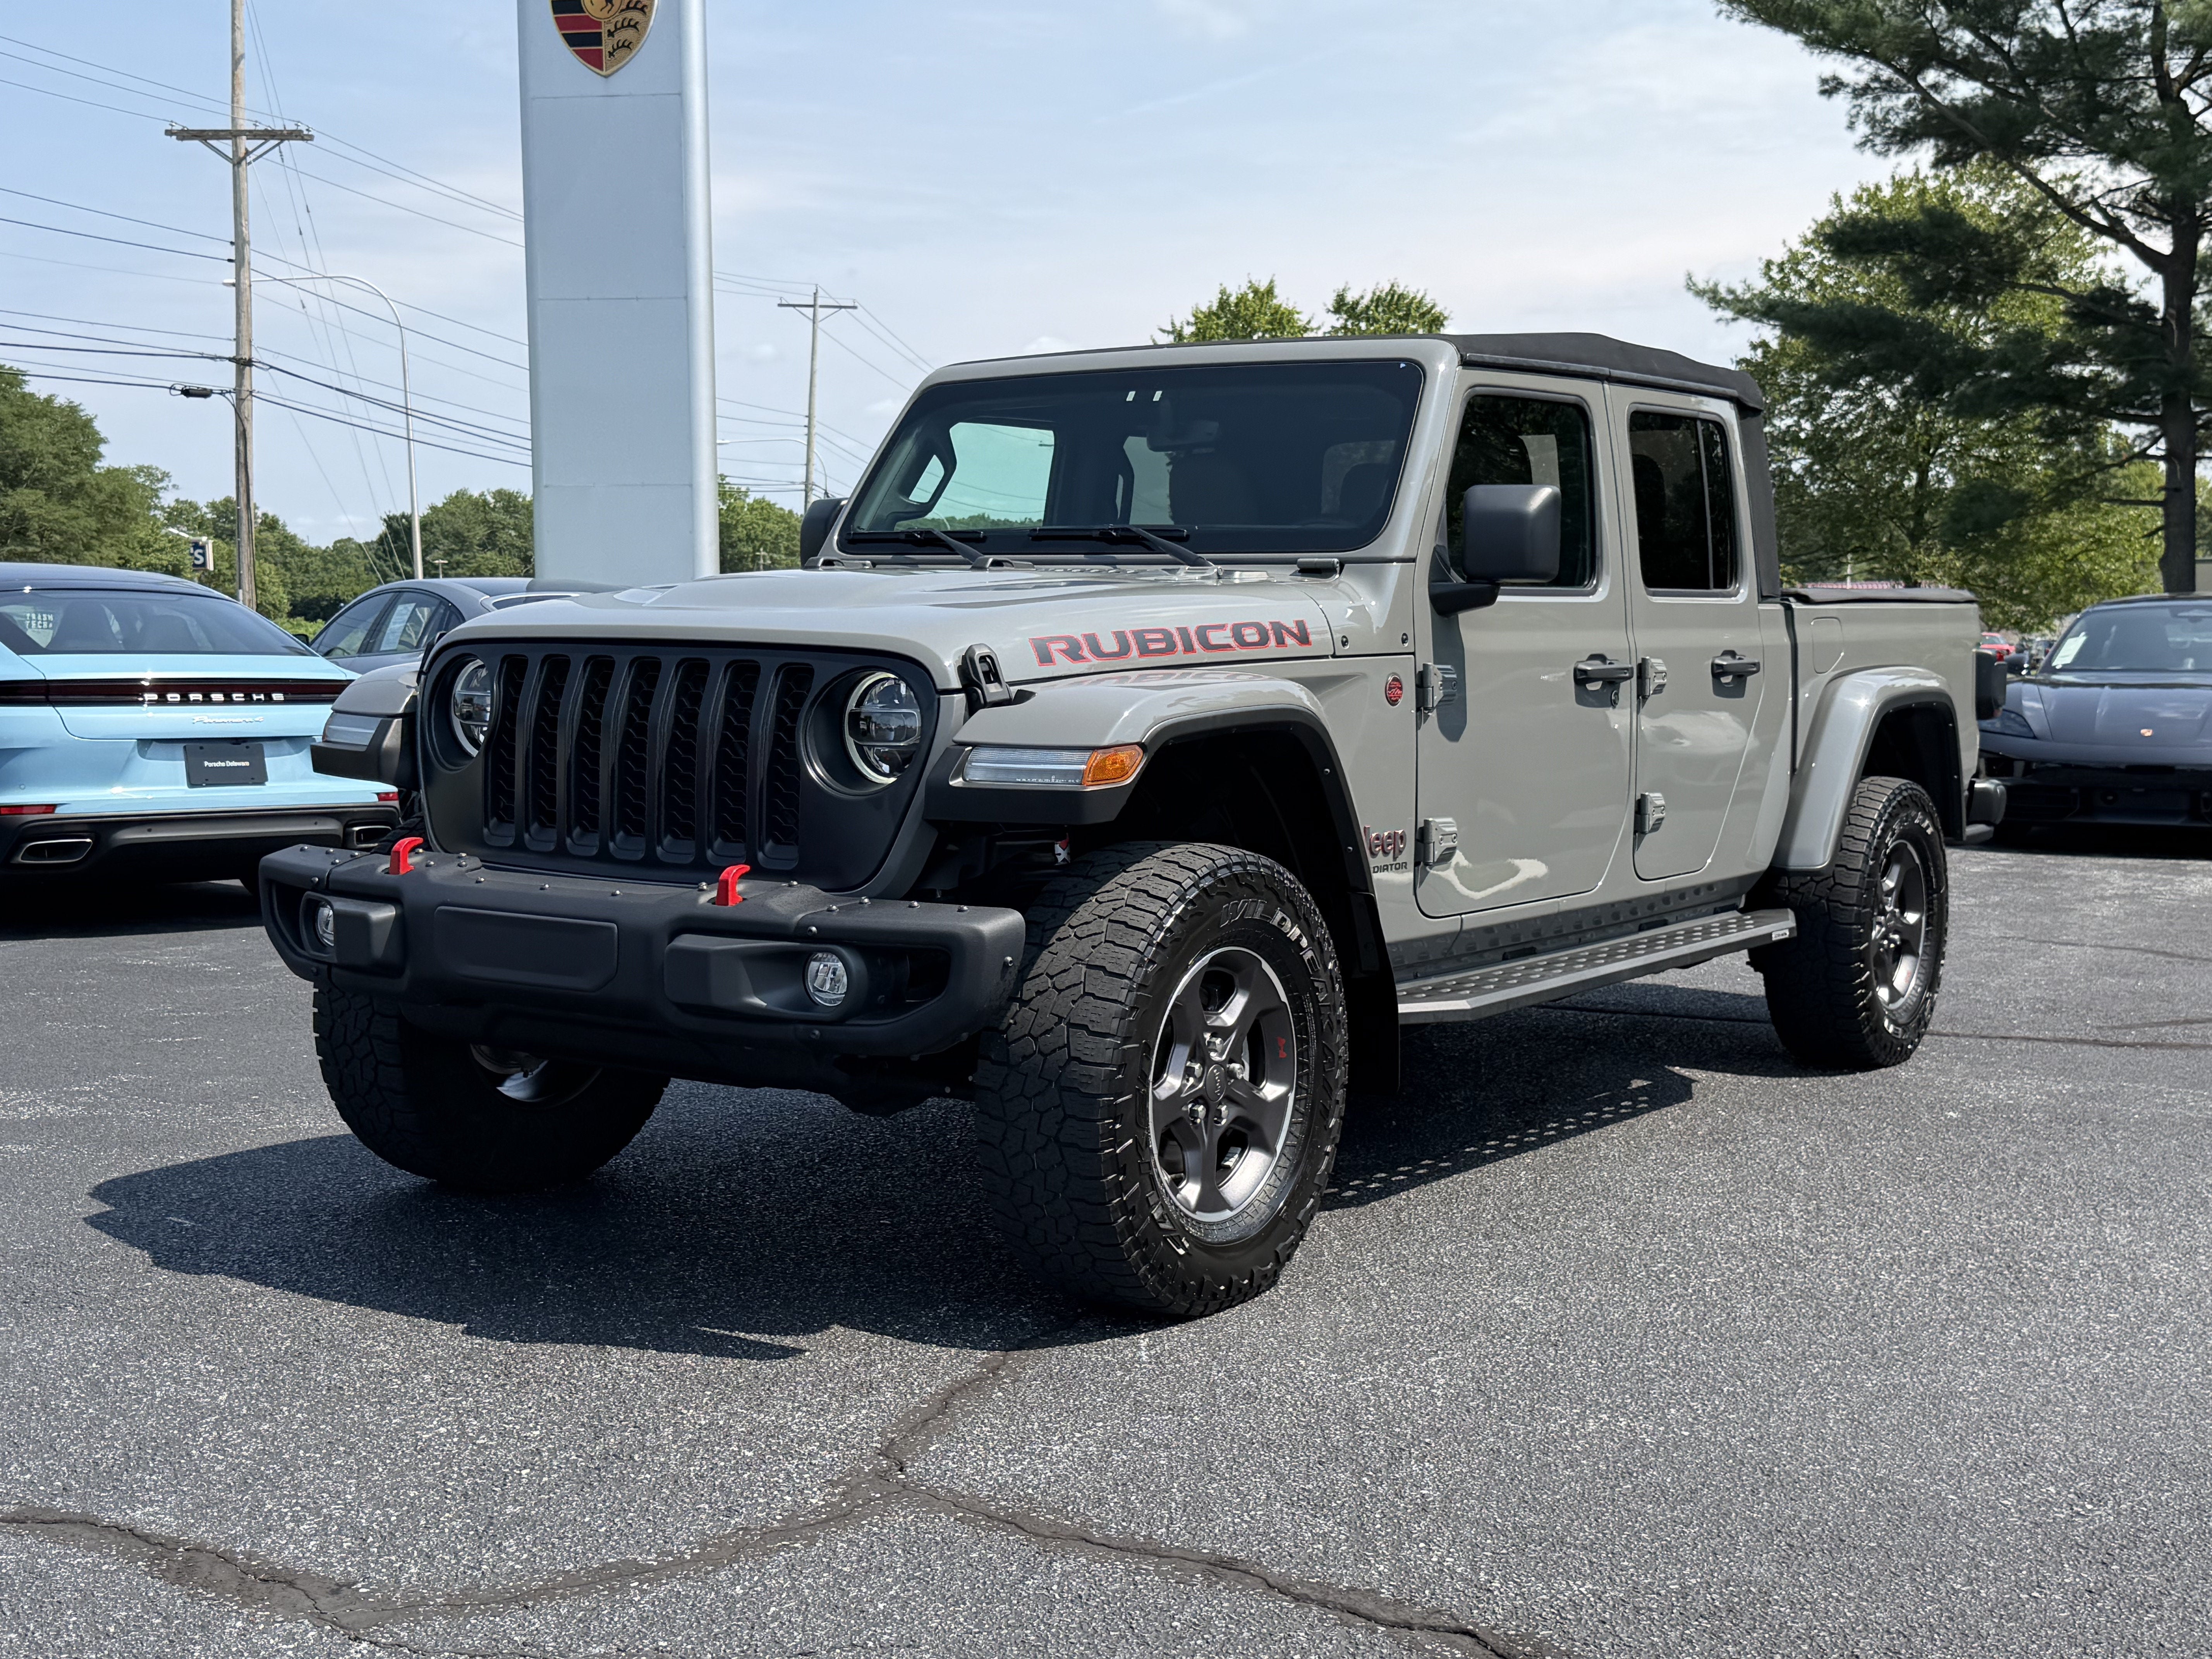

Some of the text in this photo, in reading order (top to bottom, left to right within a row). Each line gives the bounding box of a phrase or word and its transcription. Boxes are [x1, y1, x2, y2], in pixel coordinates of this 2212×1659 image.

[1028, 620, 1312, 666] RUBICON
[143, 693, 284, 701] PORSCHE
[1220, 898, 1333, 1032] WILDPEAK
